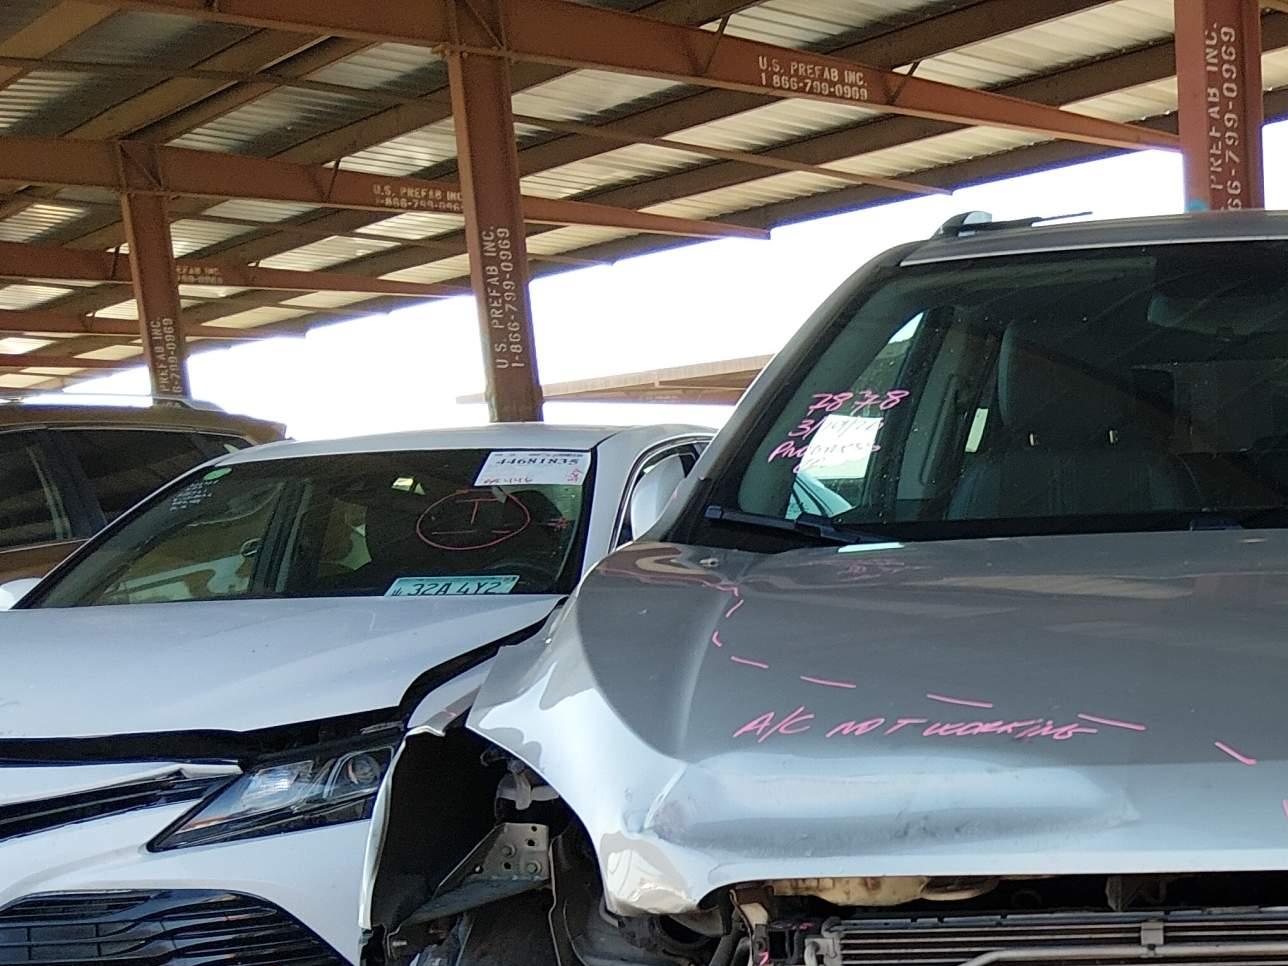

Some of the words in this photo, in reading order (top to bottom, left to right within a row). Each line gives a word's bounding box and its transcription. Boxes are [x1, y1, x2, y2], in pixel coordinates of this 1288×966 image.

[758, 56, 784, 73] U.S.
[790, 62, 839, 82] PREFAB
[844, 69, 868, 86] INC.
[1204, 22, 1219, 72] INC.
[1207, 87, 1224, 190] PREFAB
[481, 225, 497, 257] INC.
[485, 265, 505, 329] PREFAB
[496, 227, 525, 368] 1-866-799-0969
[732, 705, 815, 744] A/C
[825, 708, 928, 739] NOT
